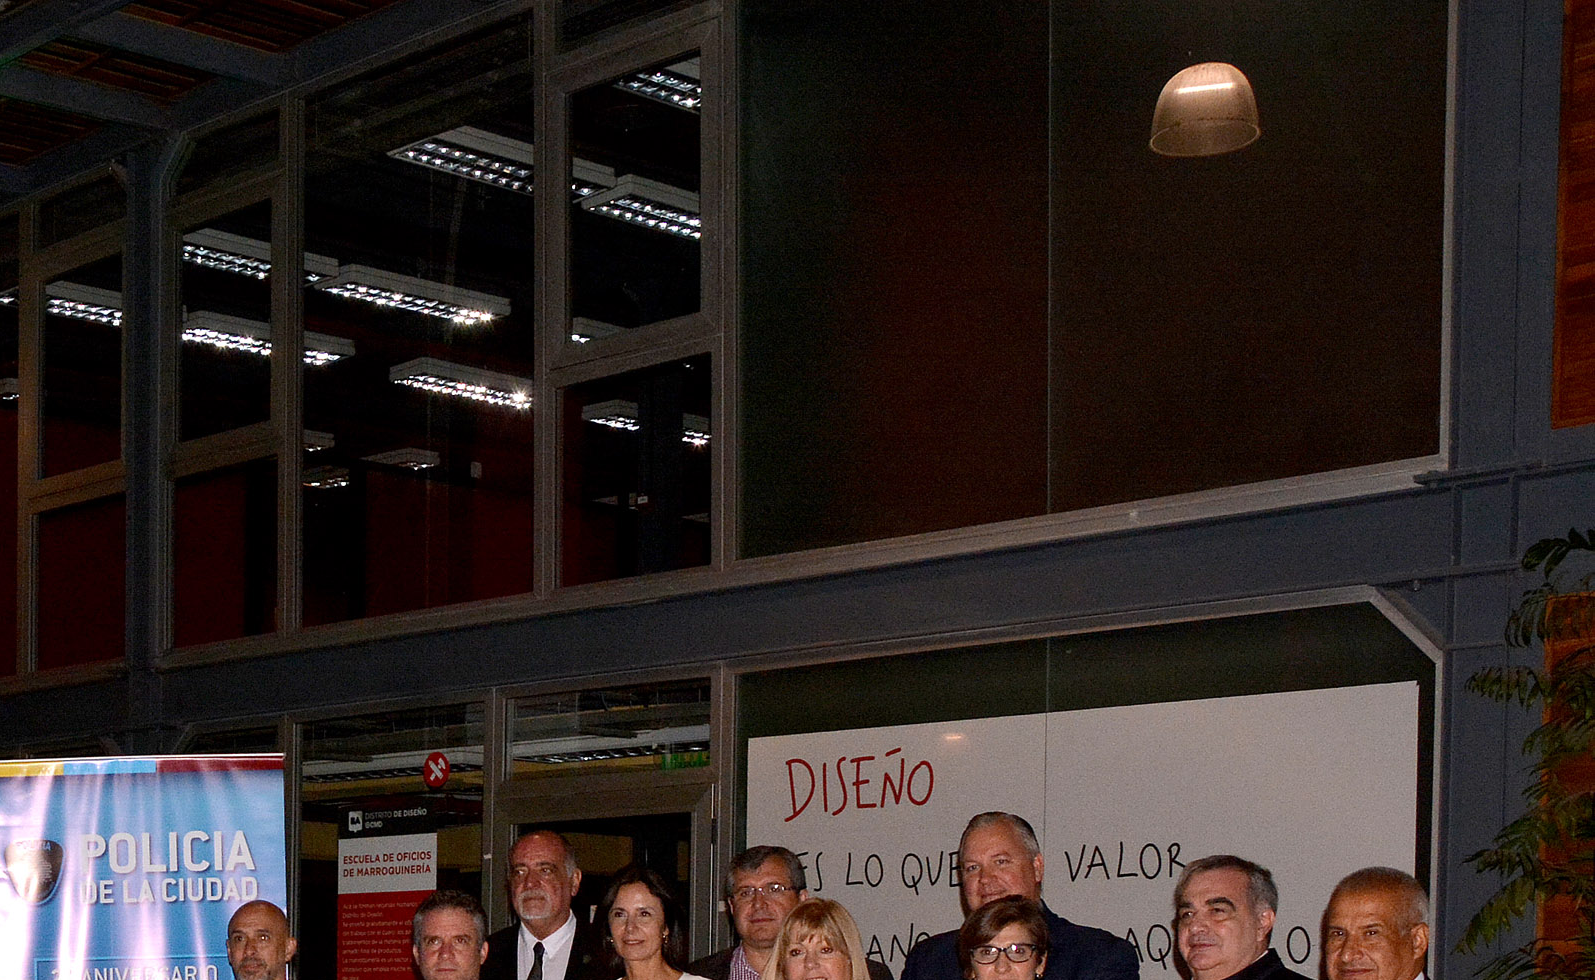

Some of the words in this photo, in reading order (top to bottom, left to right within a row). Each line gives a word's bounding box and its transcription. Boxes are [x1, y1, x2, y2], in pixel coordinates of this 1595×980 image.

[784, 747, 935, 823] DISEÑO
[393, 810, 402, 818] DE
[403, 807, 428, 817] DISEÑO
[82, 830, 255, 875] POLICIA
[343, 854, 380, 864] ESCUELA
[382, 853, 394, 862] DE
[396, 851, 432, 861] OFICIOS
[343, 868, 355, 877] DE
[357, 862, 431, 877] MARROQUINERÍA
[1064, 841, 1186, 882] VALOR
[82, 879, 114, 904] DE
[123, 878, 155, 903] LA
[162, 876, 258, 903] CIUDAD
[846, 852, 884, 887] LO
[901, 851, 963, 895] QUE
